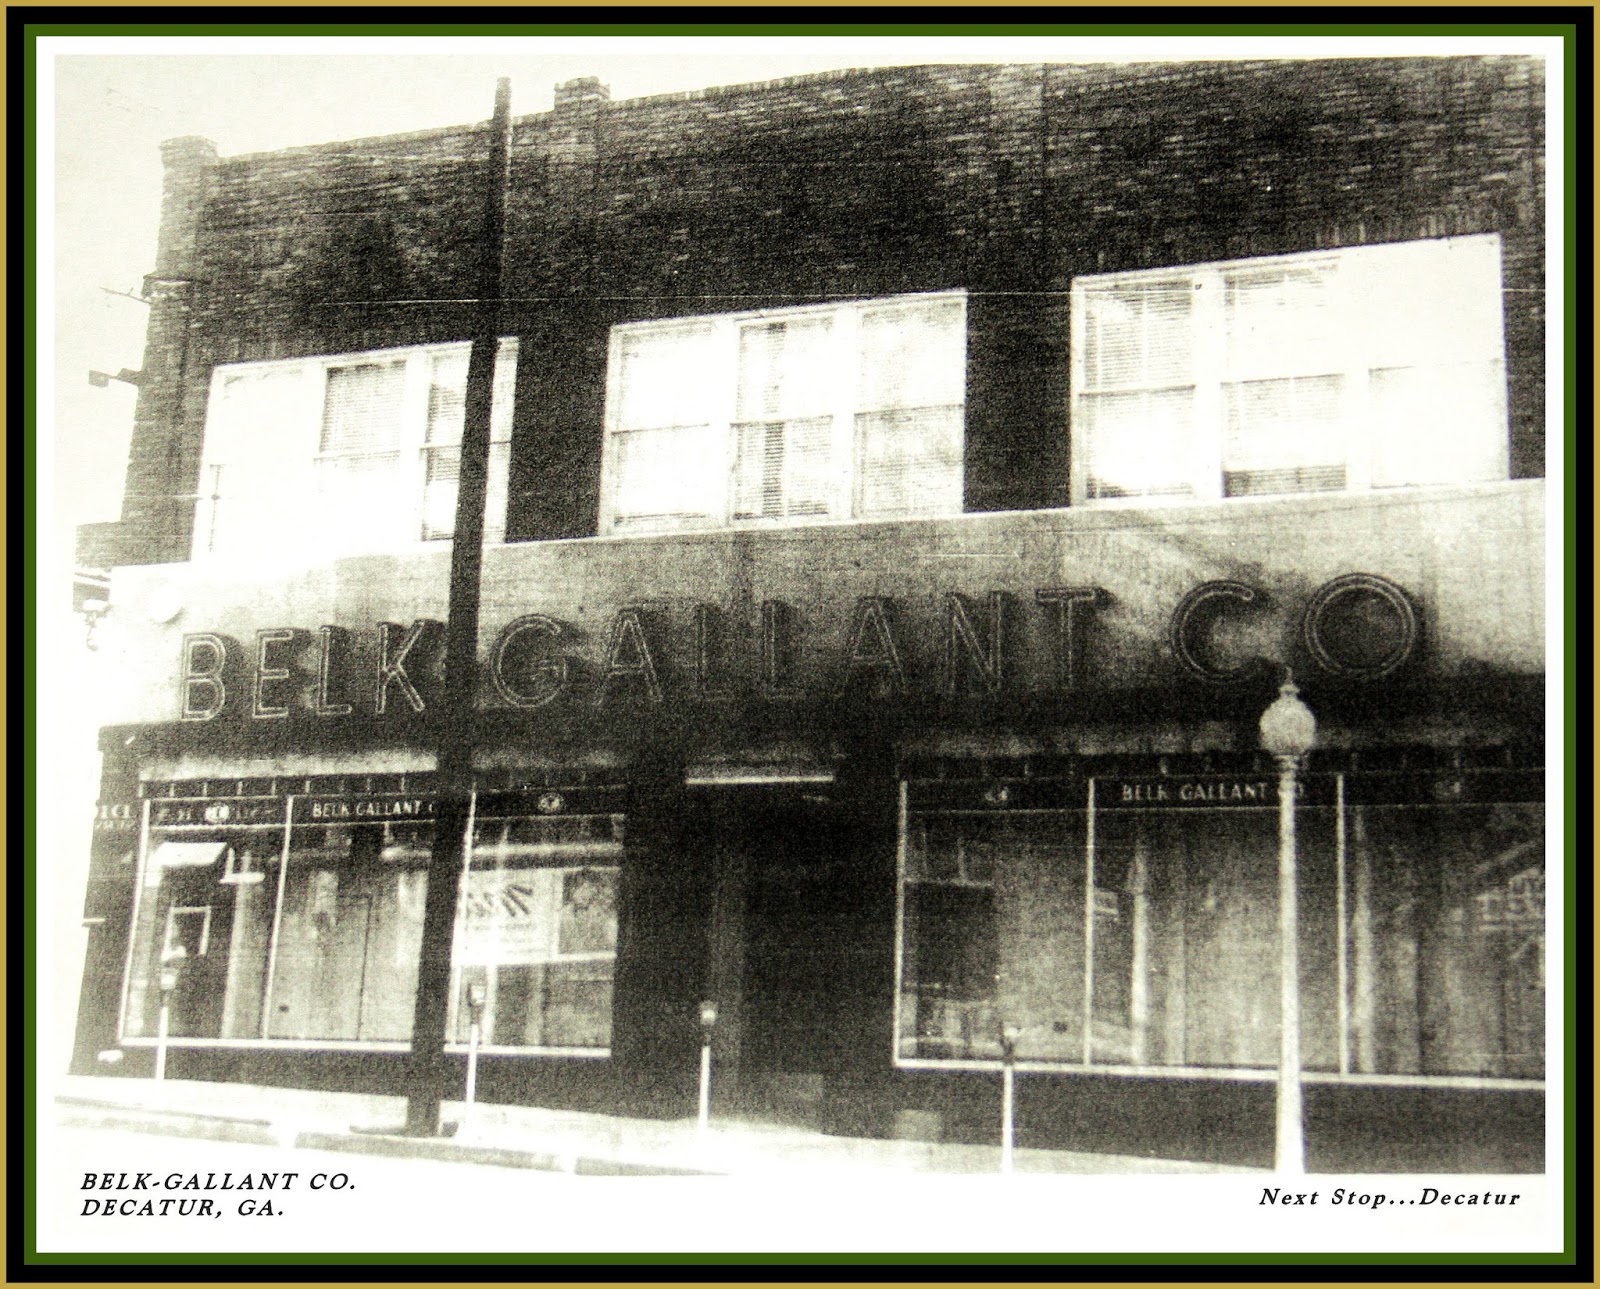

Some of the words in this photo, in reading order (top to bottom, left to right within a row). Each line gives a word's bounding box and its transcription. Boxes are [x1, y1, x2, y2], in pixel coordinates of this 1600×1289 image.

[180, 618, 427, 722] BELK
[490, 586, 1098, 708] GALLANT
[1169, 571, 1417, 686] CO
[1179, 781, 1268, 801] GALLANT
